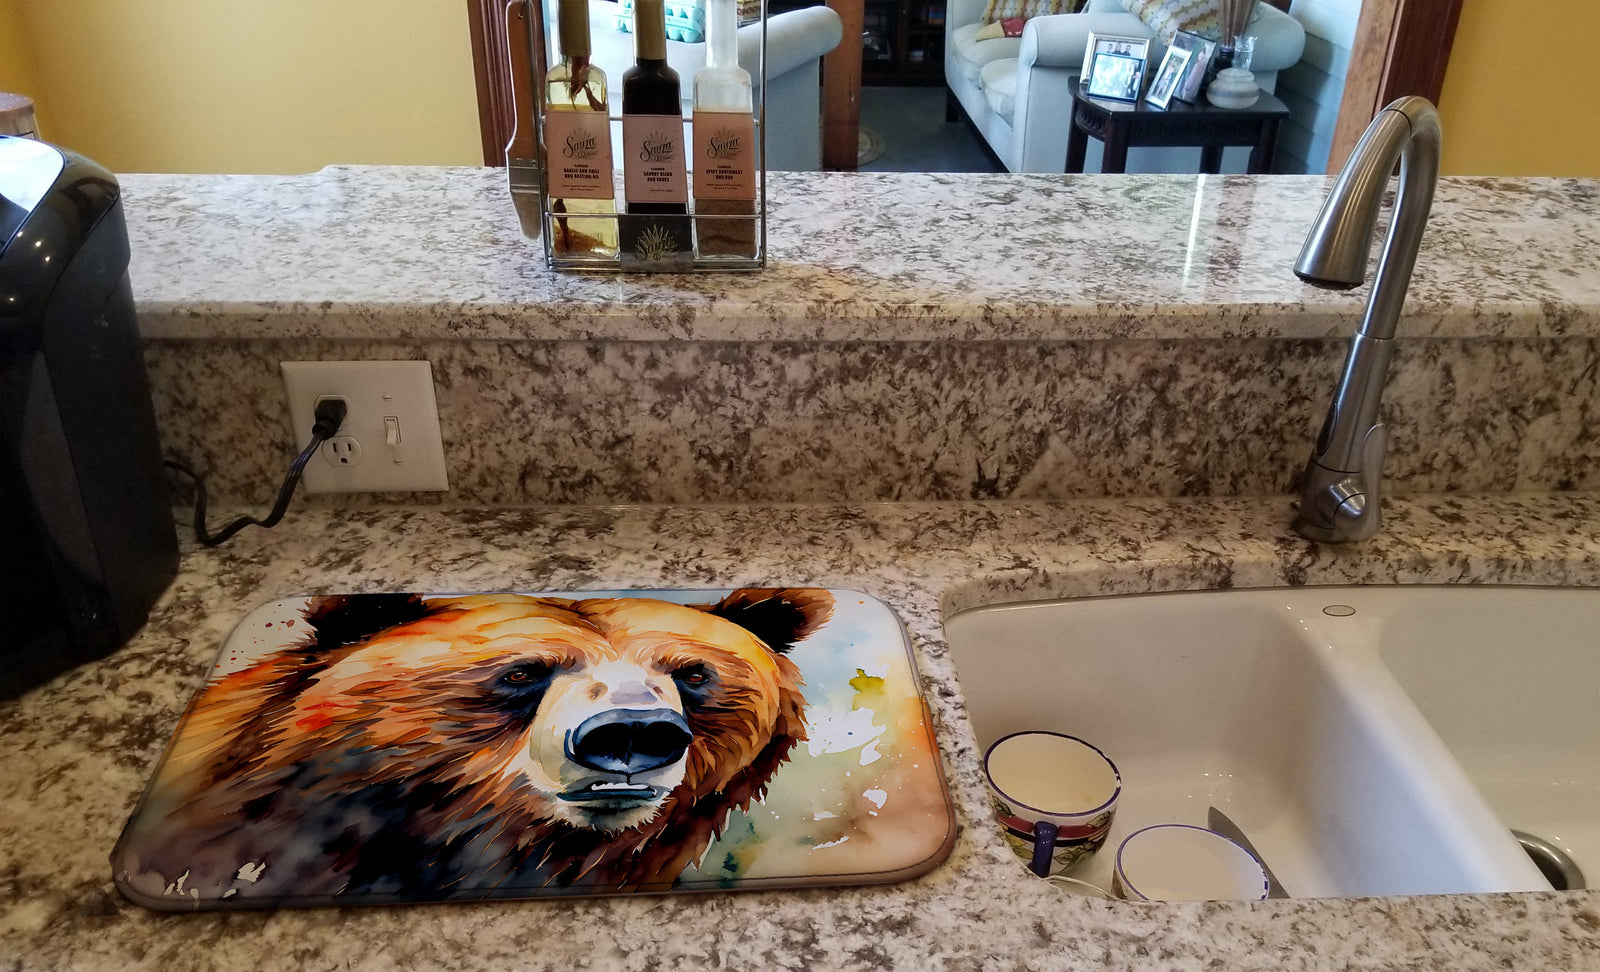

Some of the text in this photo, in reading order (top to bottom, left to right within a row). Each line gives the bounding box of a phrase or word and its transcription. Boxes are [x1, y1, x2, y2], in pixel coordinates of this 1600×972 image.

[563, 136, 598, 158] Sauza
[640, 140, 674, 162] Sauza
[707, 136, 740, 159] Sauza
